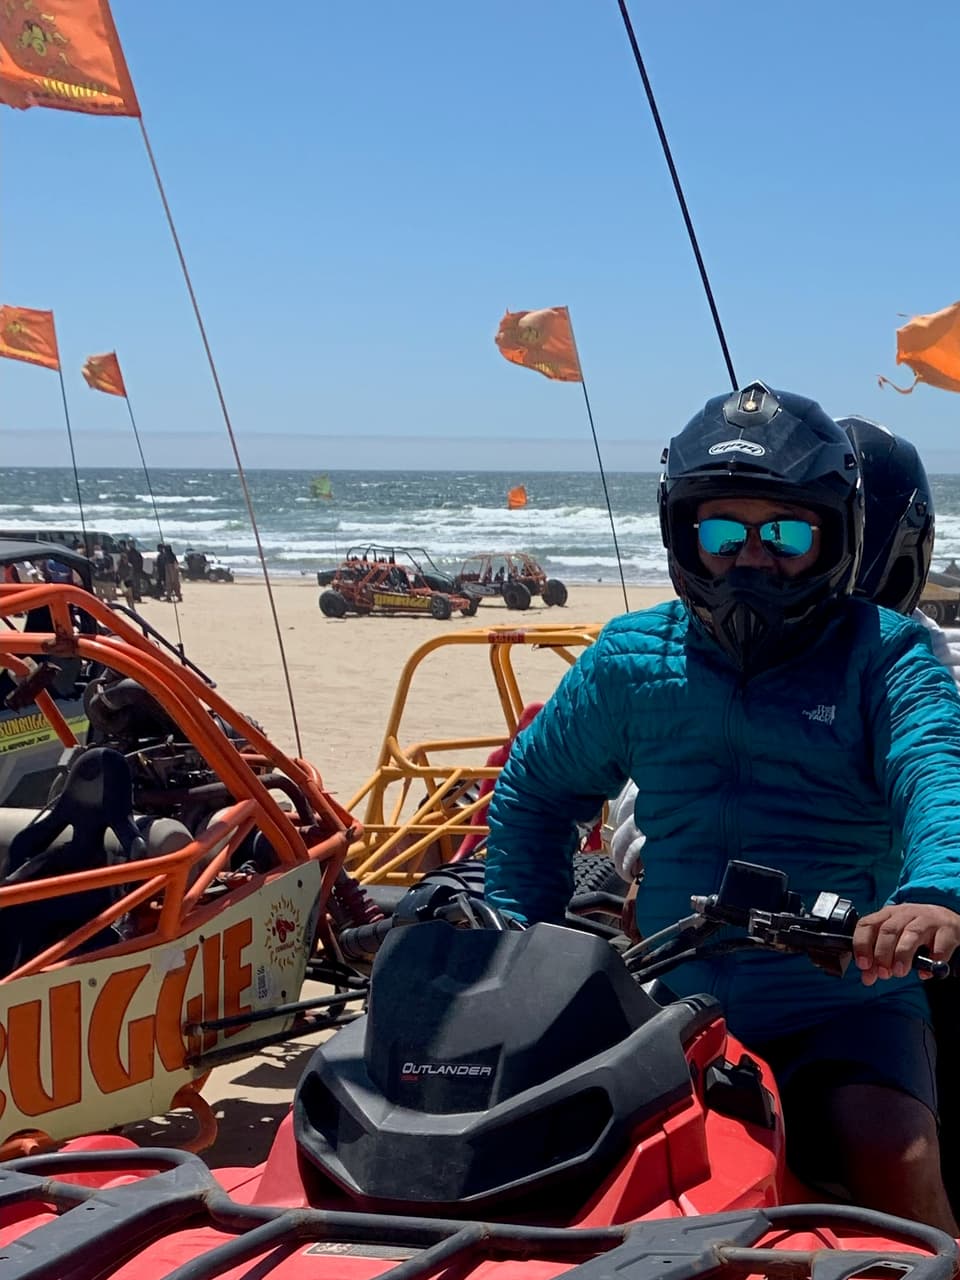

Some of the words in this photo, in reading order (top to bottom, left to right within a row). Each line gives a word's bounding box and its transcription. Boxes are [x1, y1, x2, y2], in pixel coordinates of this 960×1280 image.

[0, 712, 48, 738] SUNBUGG
[0, 918, 252, 1117] UGGIE
[402, 1062, 492, 1076] OUTLANDER
